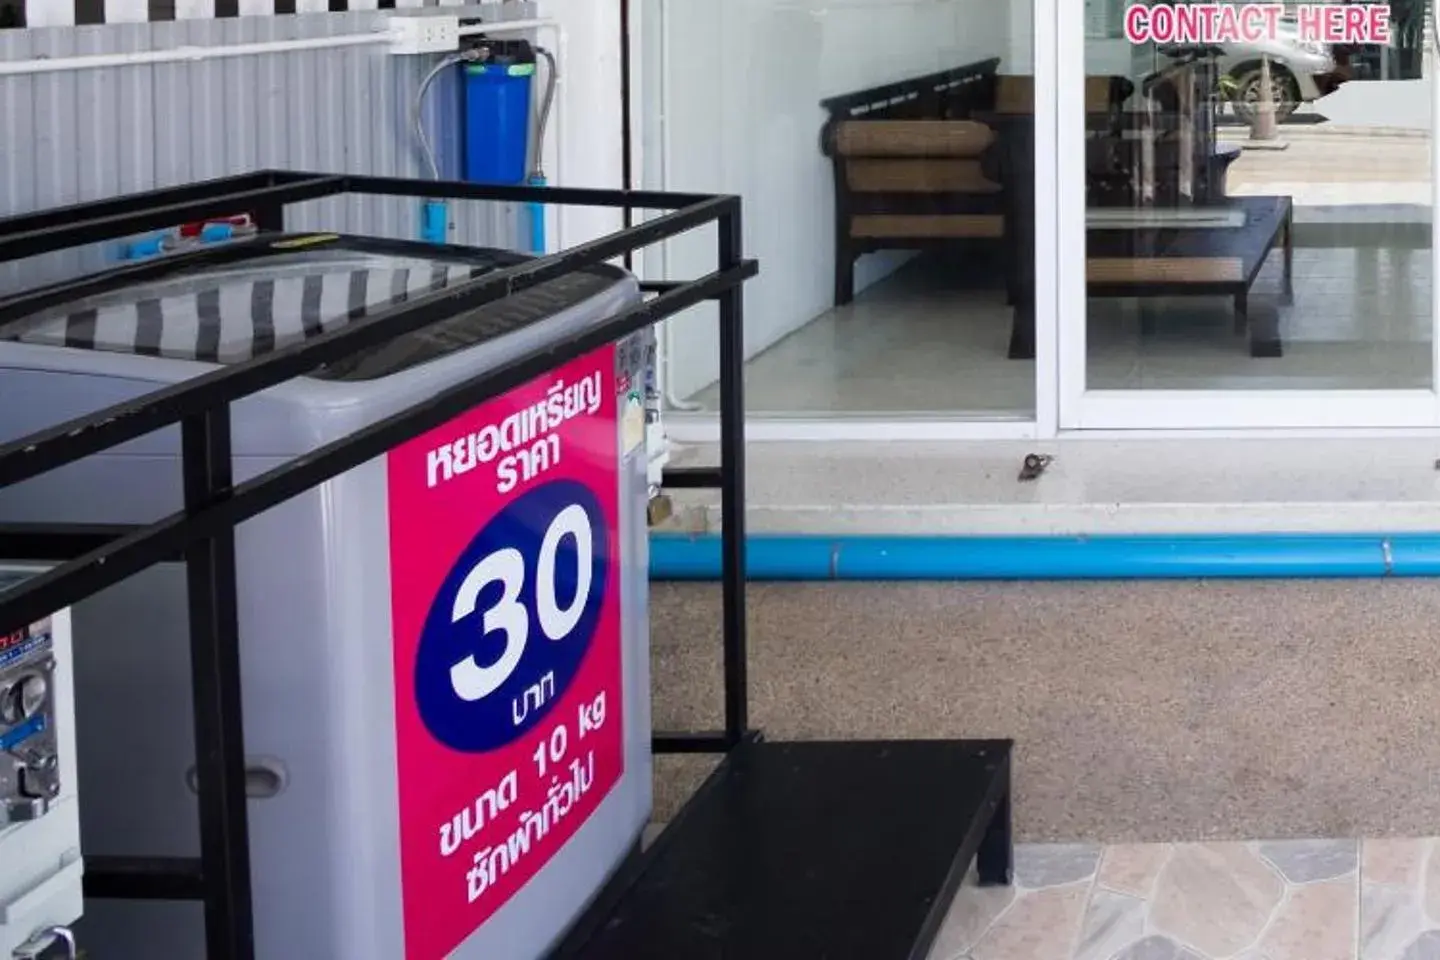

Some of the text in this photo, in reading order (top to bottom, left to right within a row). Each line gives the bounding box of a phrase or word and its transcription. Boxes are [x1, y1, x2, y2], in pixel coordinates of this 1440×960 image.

[1126, 5, 1391, 43] CONTACT HERE
[427, 370, 601, 488] หยอดเหรียญ
[497, 433, 560, 493] ราคา
[450, 503, 592, 701] 30
[512, 671, 554, 725] บาท
[440, 690, 606, 856] ขนาด 10 kg
[466, 750, 594, 903] ซักผ้าทั่วไป
